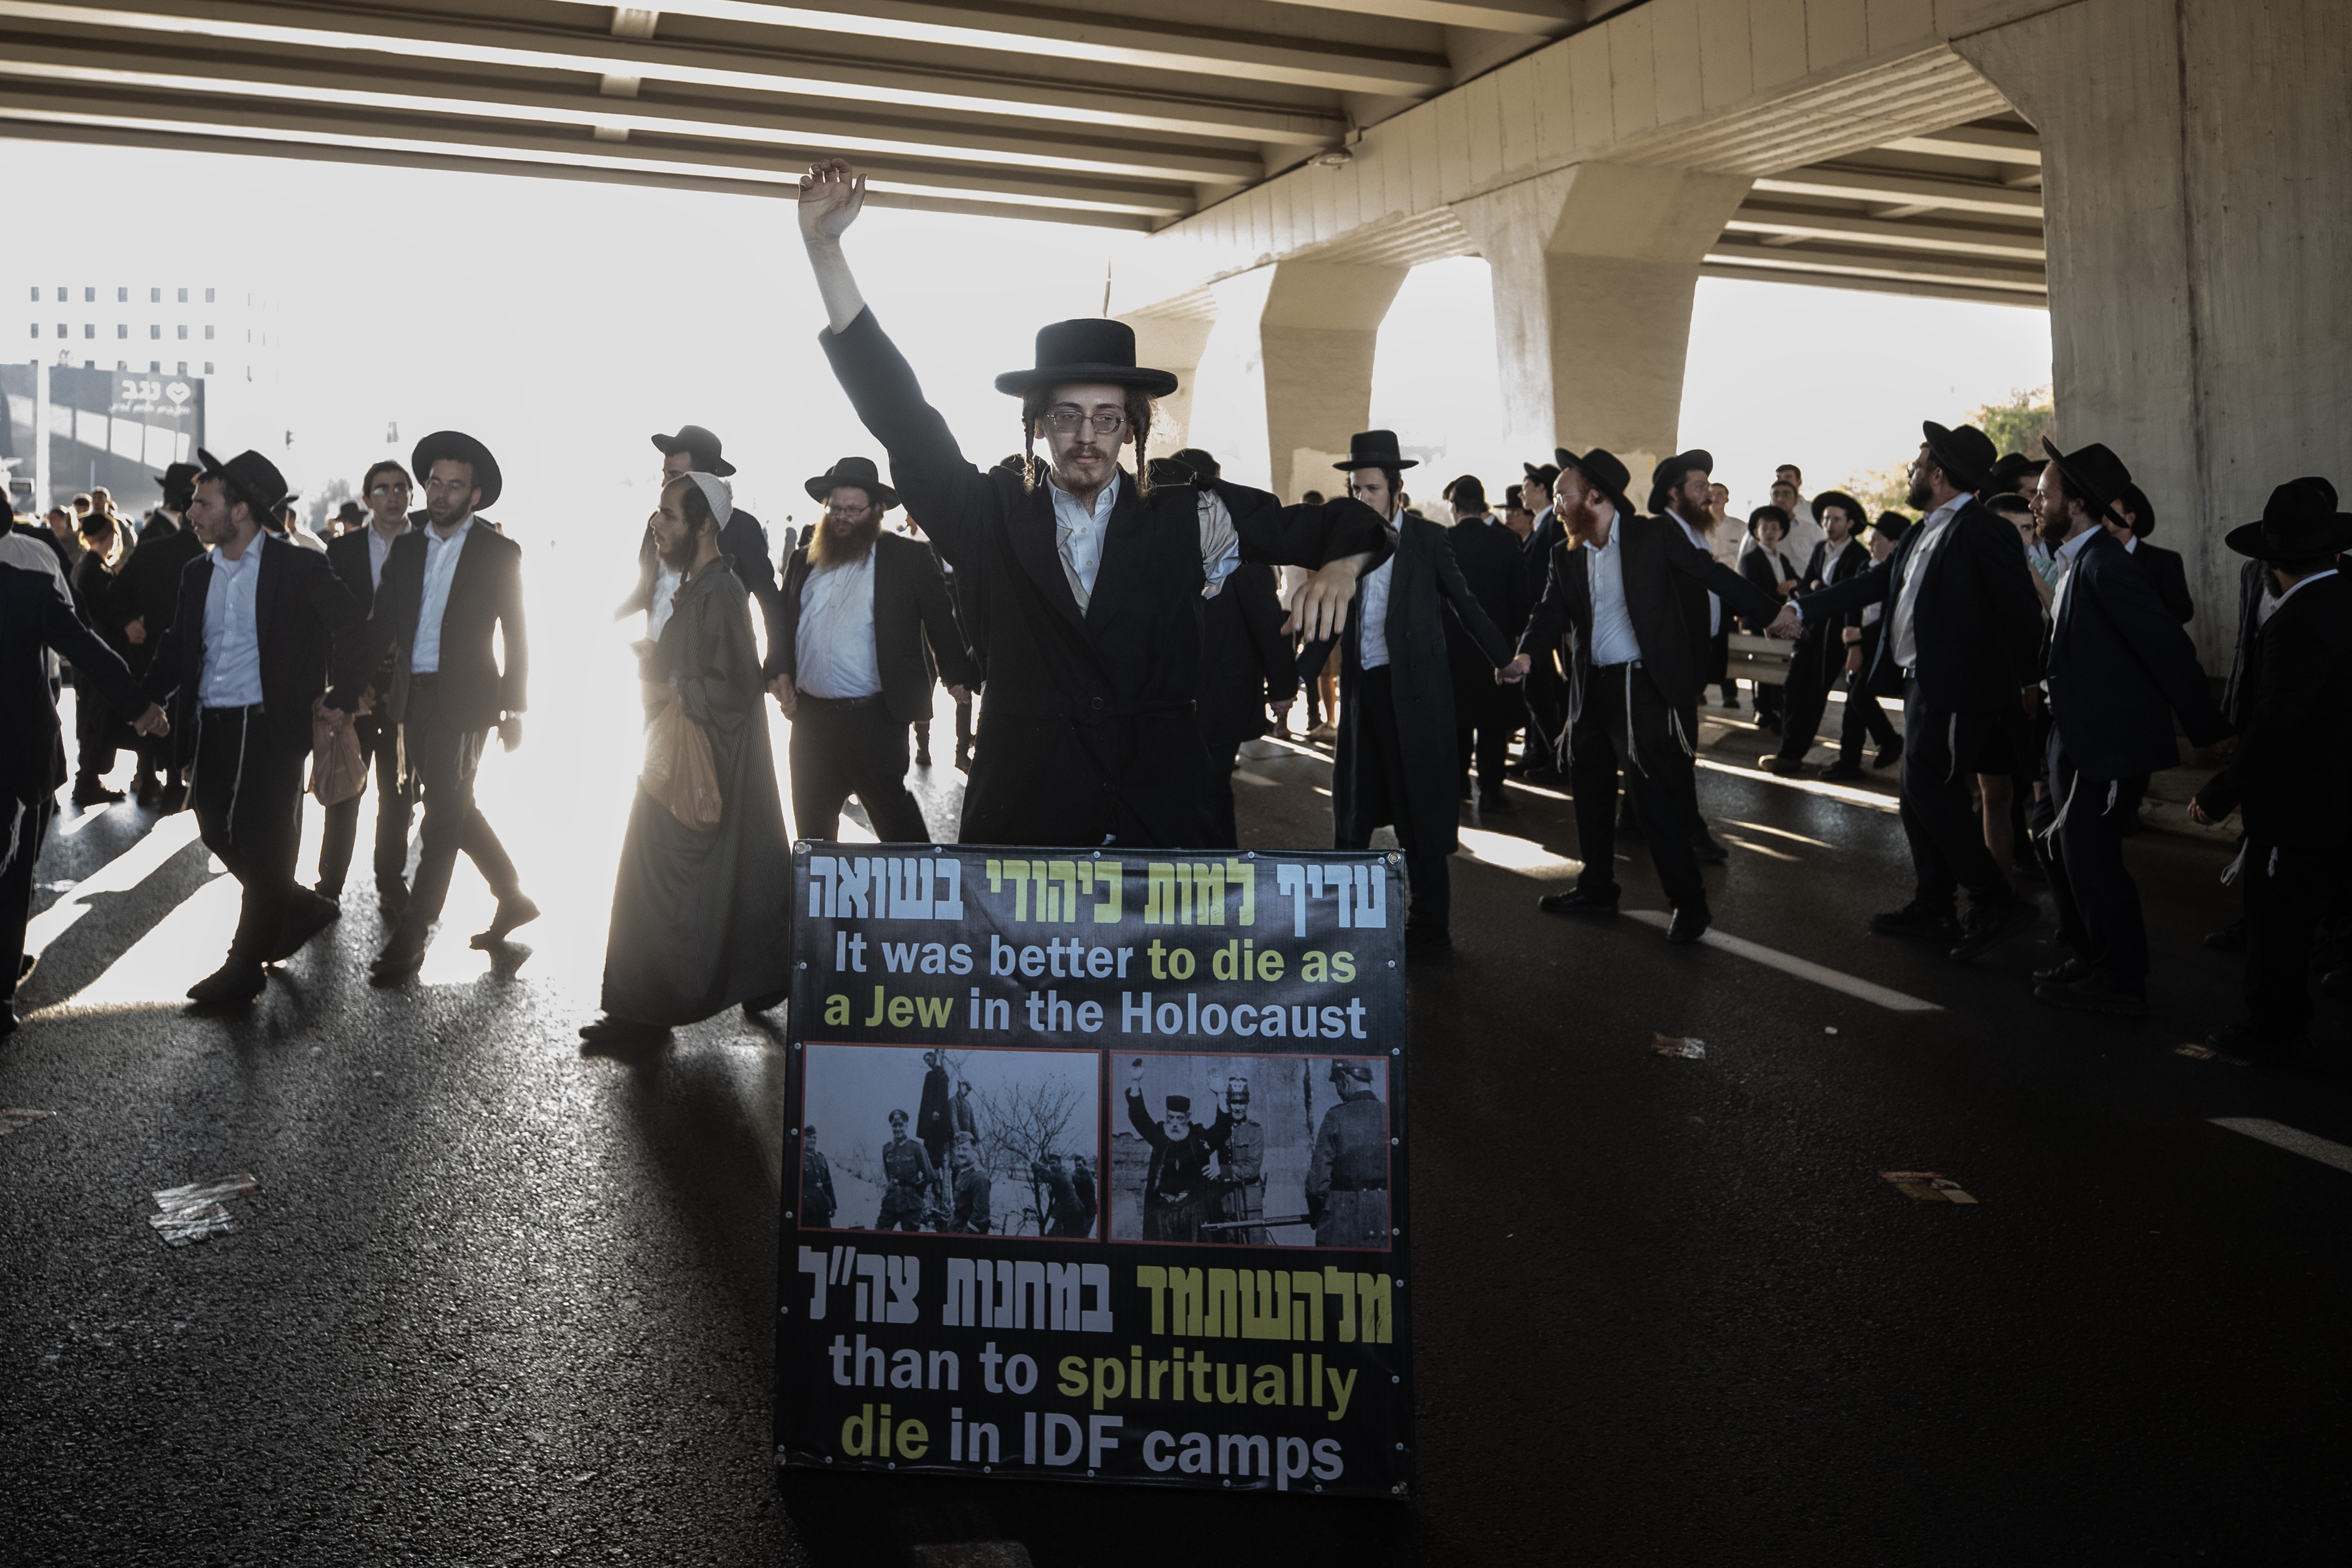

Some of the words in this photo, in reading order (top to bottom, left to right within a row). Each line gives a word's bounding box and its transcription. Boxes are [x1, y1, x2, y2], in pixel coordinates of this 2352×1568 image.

[808, 856, 963, 920] בשואה
[986, 860, 1122, 923] כיהודי
[1144, 858, 1255, 926] למות
[1277, 864, 1386, 937] עדיף
[836, 931, 867, 972] It
[882, 943, 973, 975] was
[991, 935, 1133, 978] better
[1147, 939, 1195, 979] to
[1213, 939, 1284, 981] die
[1302, 951, 1355, 983] as
[824, 994, 849, 1025] a
[866, 986, 953, 1028] Jew
[970, 988, 1009, 1030] in
[1025, 990, 1103, 1032] the
[1122, 992, 1366, 1038] Holocaust
[943, 1258, 1113, 1332] במחנות
[1137, 1266, 1392, 1343] מלהשתמד
[829, 1334, 959, 1390] than
[980, 1342, 1038, 1394] to
[1057, 1345, 1358, 1420] spiritually
[842, 1404, 928, 1459] die
[951, 1408, 999, 1463] in
[1024, 1412, 1123, 1467] IDF
[1143, 1431, 1343, 1490] camps
